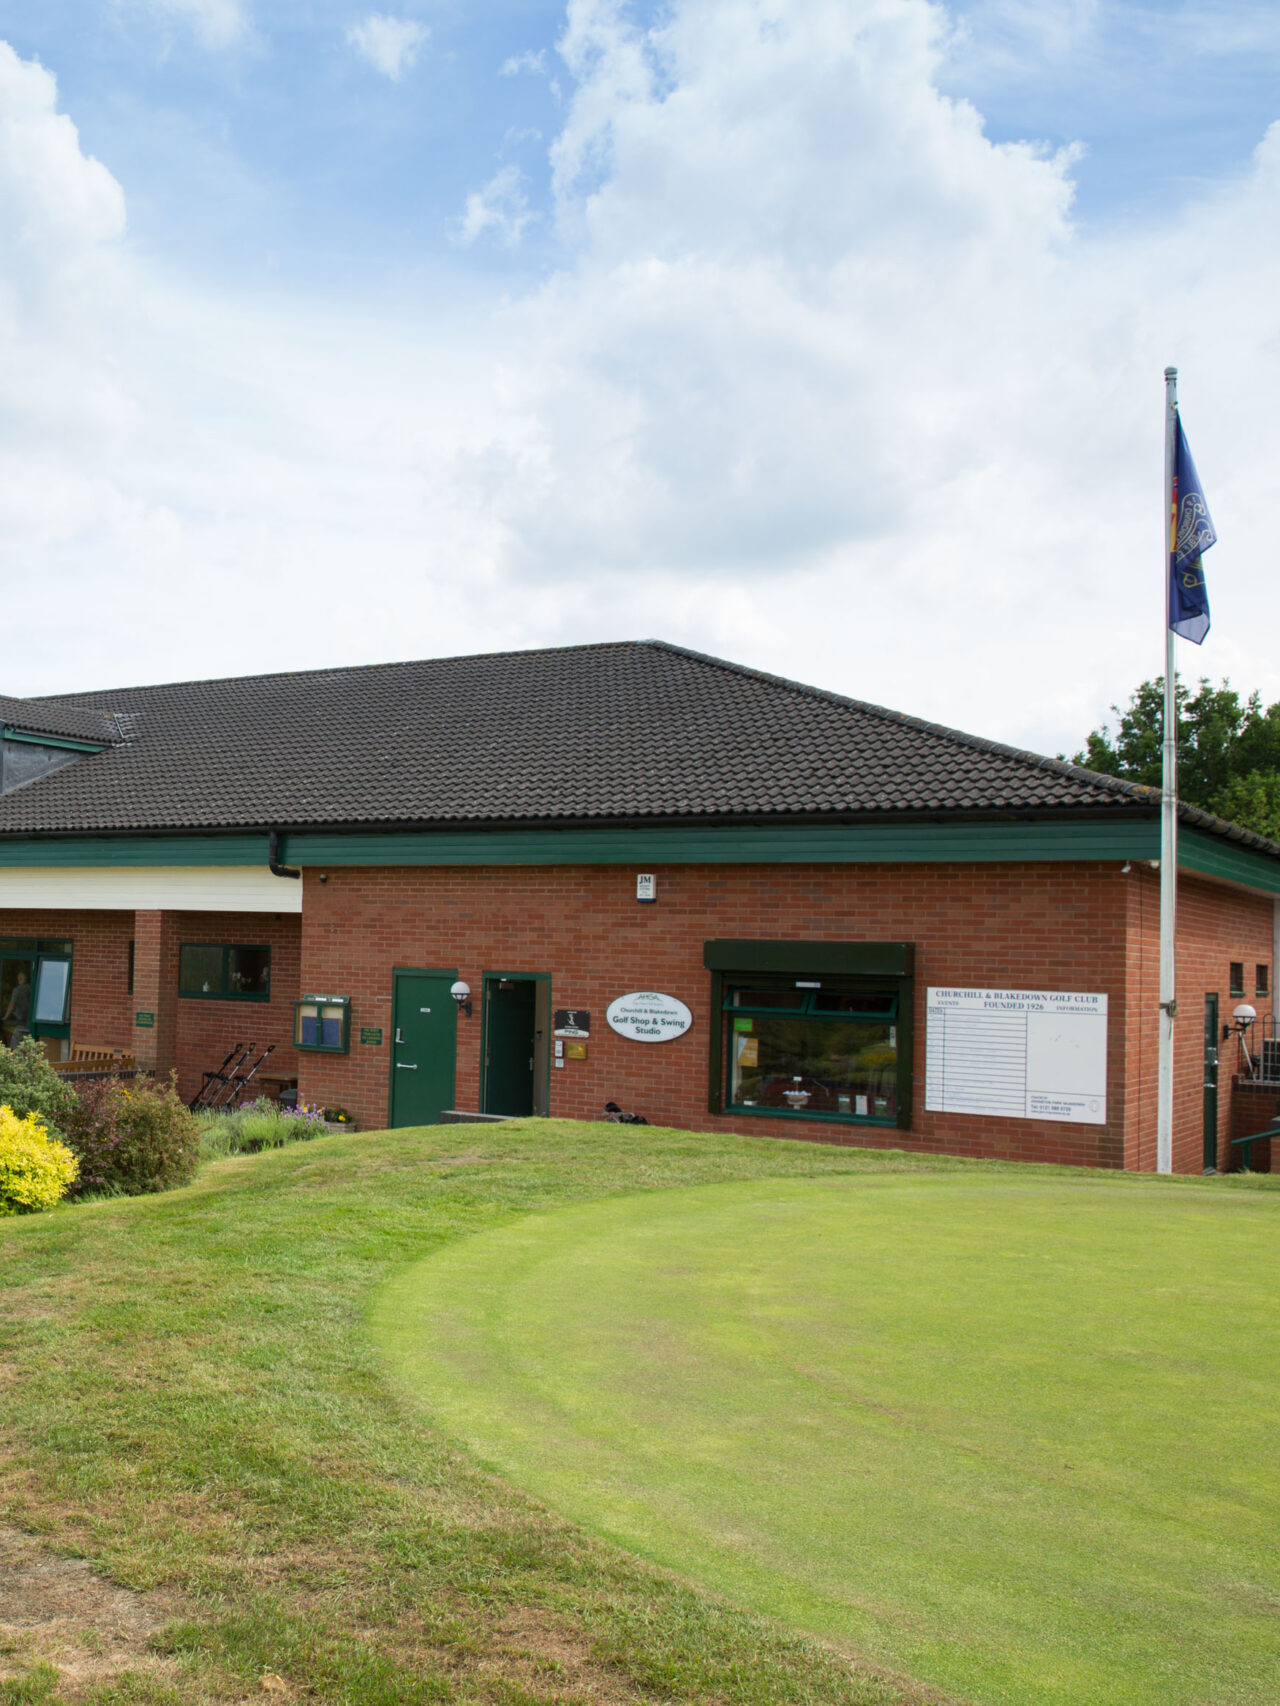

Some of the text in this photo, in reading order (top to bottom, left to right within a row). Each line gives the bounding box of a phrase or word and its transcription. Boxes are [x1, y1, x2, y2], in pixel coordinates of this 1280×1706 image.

[936, 991, 984, 999] CHURCHILL
[985, 992, 992, 1000] &
[994, 992, 1048, 1001] BLAKEDOWN
[1074, 996, 1098, 1004] CLUB
[984, 1001, 1025, 1009] FOUNDED
[612, 1015, 629, 1023] Golf
[630, 1017, 650, 1026] Shop
[660, 1018, 685, 1029] Swing
[635, 1026, 661, 1035] Studio
